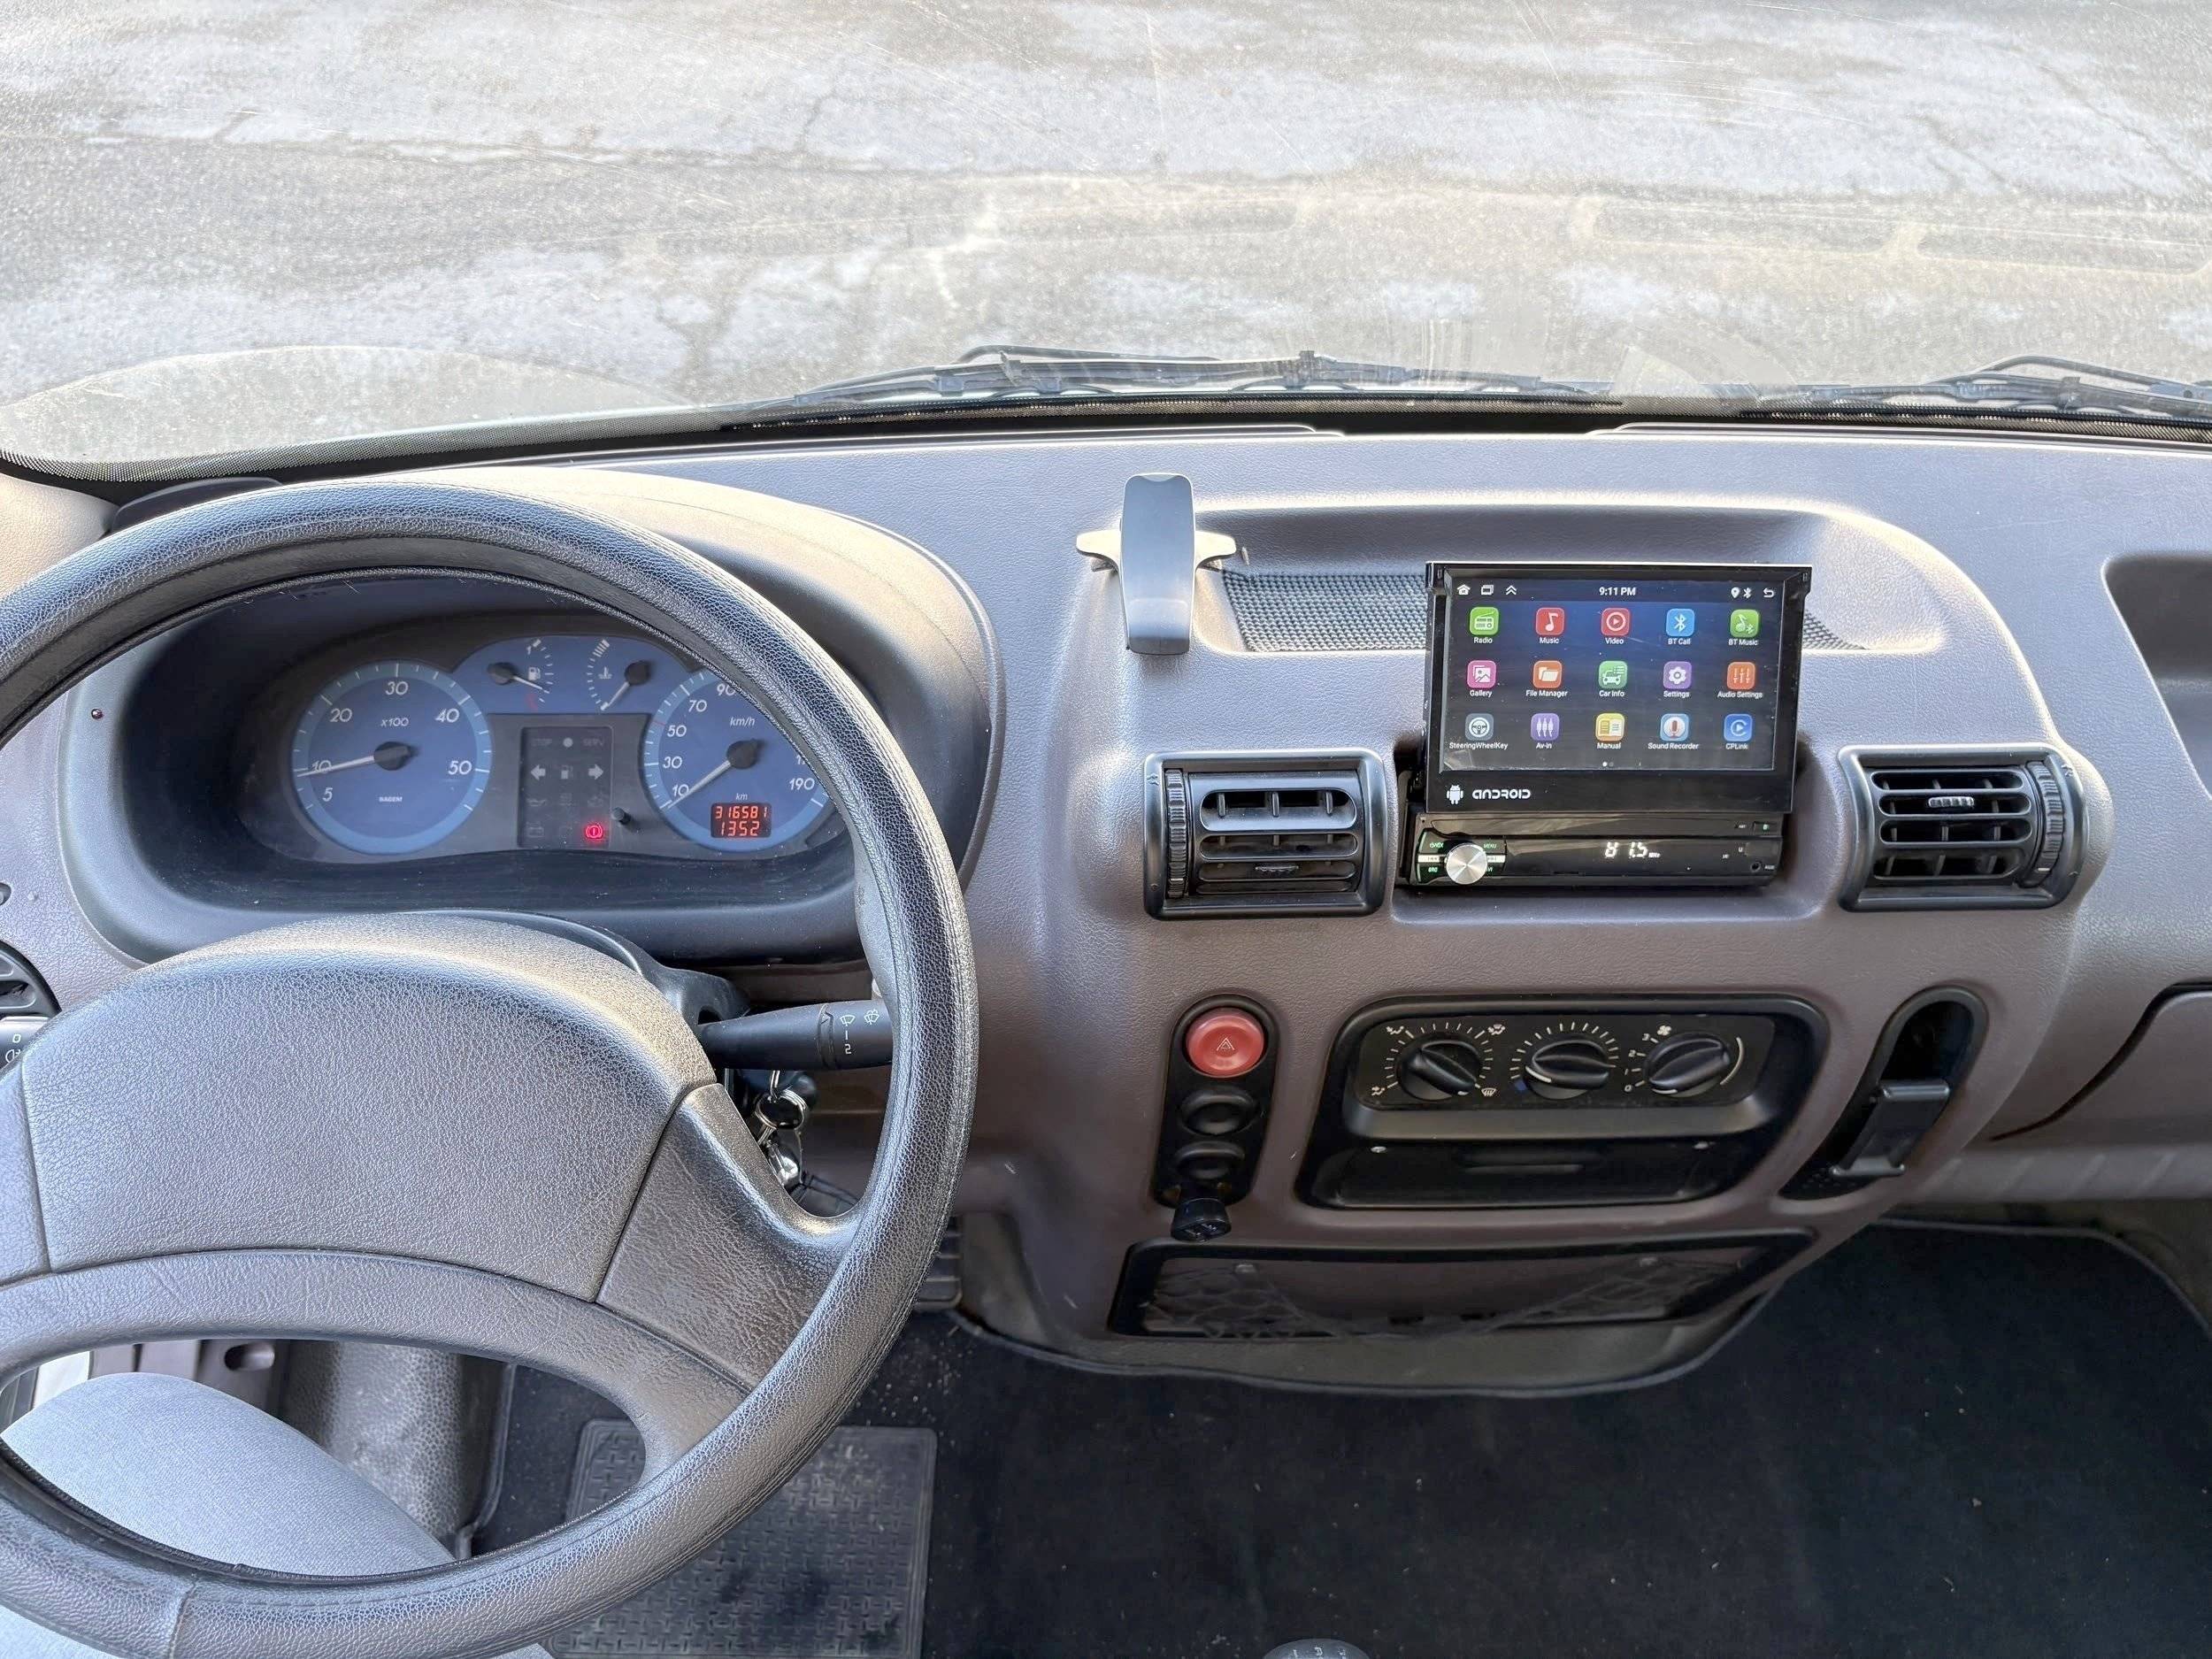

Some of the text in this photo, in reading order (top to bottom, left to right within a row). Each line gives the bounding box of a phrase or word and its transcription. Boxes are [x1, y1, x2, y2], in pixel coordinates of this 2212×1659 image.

[1598, 587, 1637, 597] 9:11 PM
[385, 680, 409, 695] 30
[717, 683, 736, 696] 90
[1663, 690, 1690, 699] Settings
[687, 699, 708, 713] 70
[329, 708, 353, 723] 20
[380, 717, 410, 727] x100
[434, 708, 460, 724] 40
[729, 716, 756, 728] km/h
[666, 725, 687, 738] 50
[448, 760, 472, 775] 50
[663, 755, 683, 769] 30
[672, 784, 690, 796] 10
[788, 777, 815, 791] 190
[322, 787, 334, 803] 5
[735, 792, 749, 801] km
[715, 805, 768, 819] 316581
[720, 820, 760, 836] 1352
[1641, 1033, 1650, 1041] 3
[844, 1043, 852, 1055] 2
[1624, 1084, 1632, 1093] 0
